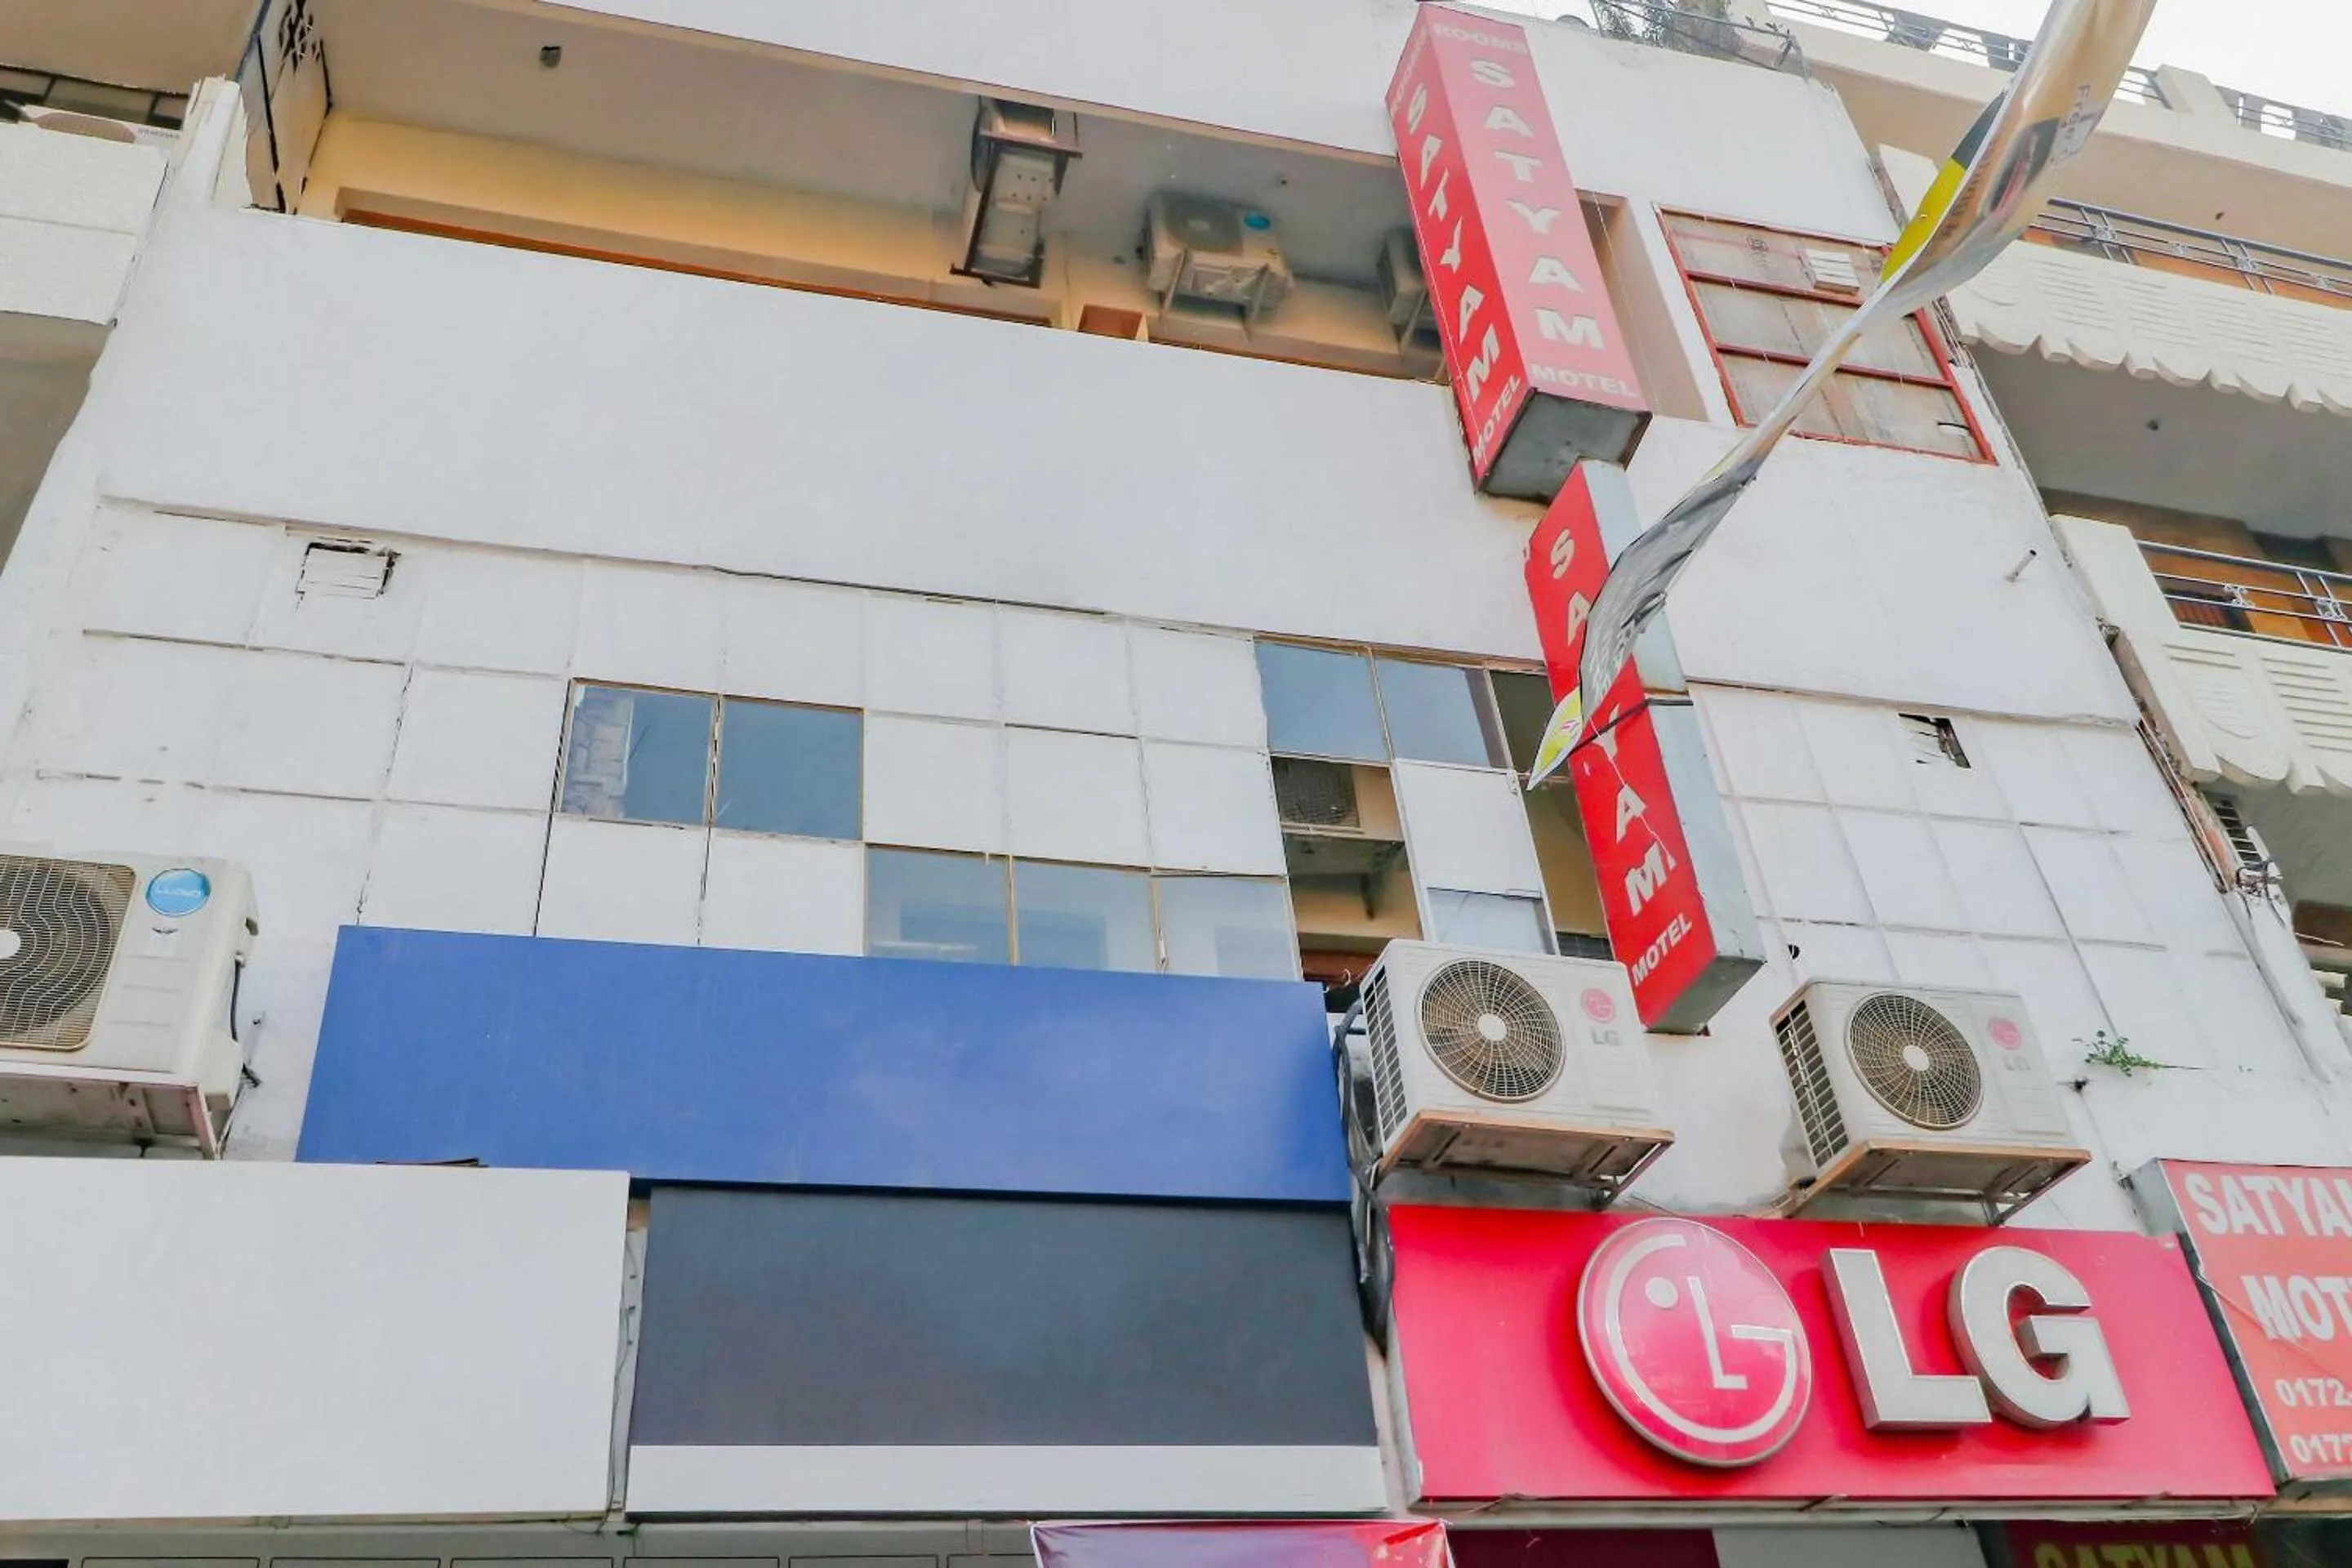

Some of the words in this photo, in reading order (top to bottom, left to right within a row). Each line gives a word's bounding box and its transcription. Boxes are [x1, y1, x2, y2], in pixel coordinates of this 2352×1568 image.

[1407, 81, 1500, 403] SATYAM
[1471, 58, 1606, 351] SATYAM
[1472, 375, 1521, 463] MOTEL
[1531, 363, 1637, 399] MOTEL
[1550, 528, 1677, 917] SAYAM
[1633, 914, 1693, 987] MOTEL
[1591, 1027, 1623, 1046] LG
[1822, 1245, 2130, 1429] LG
[2239, 1274, 2352, 1341] MOT
